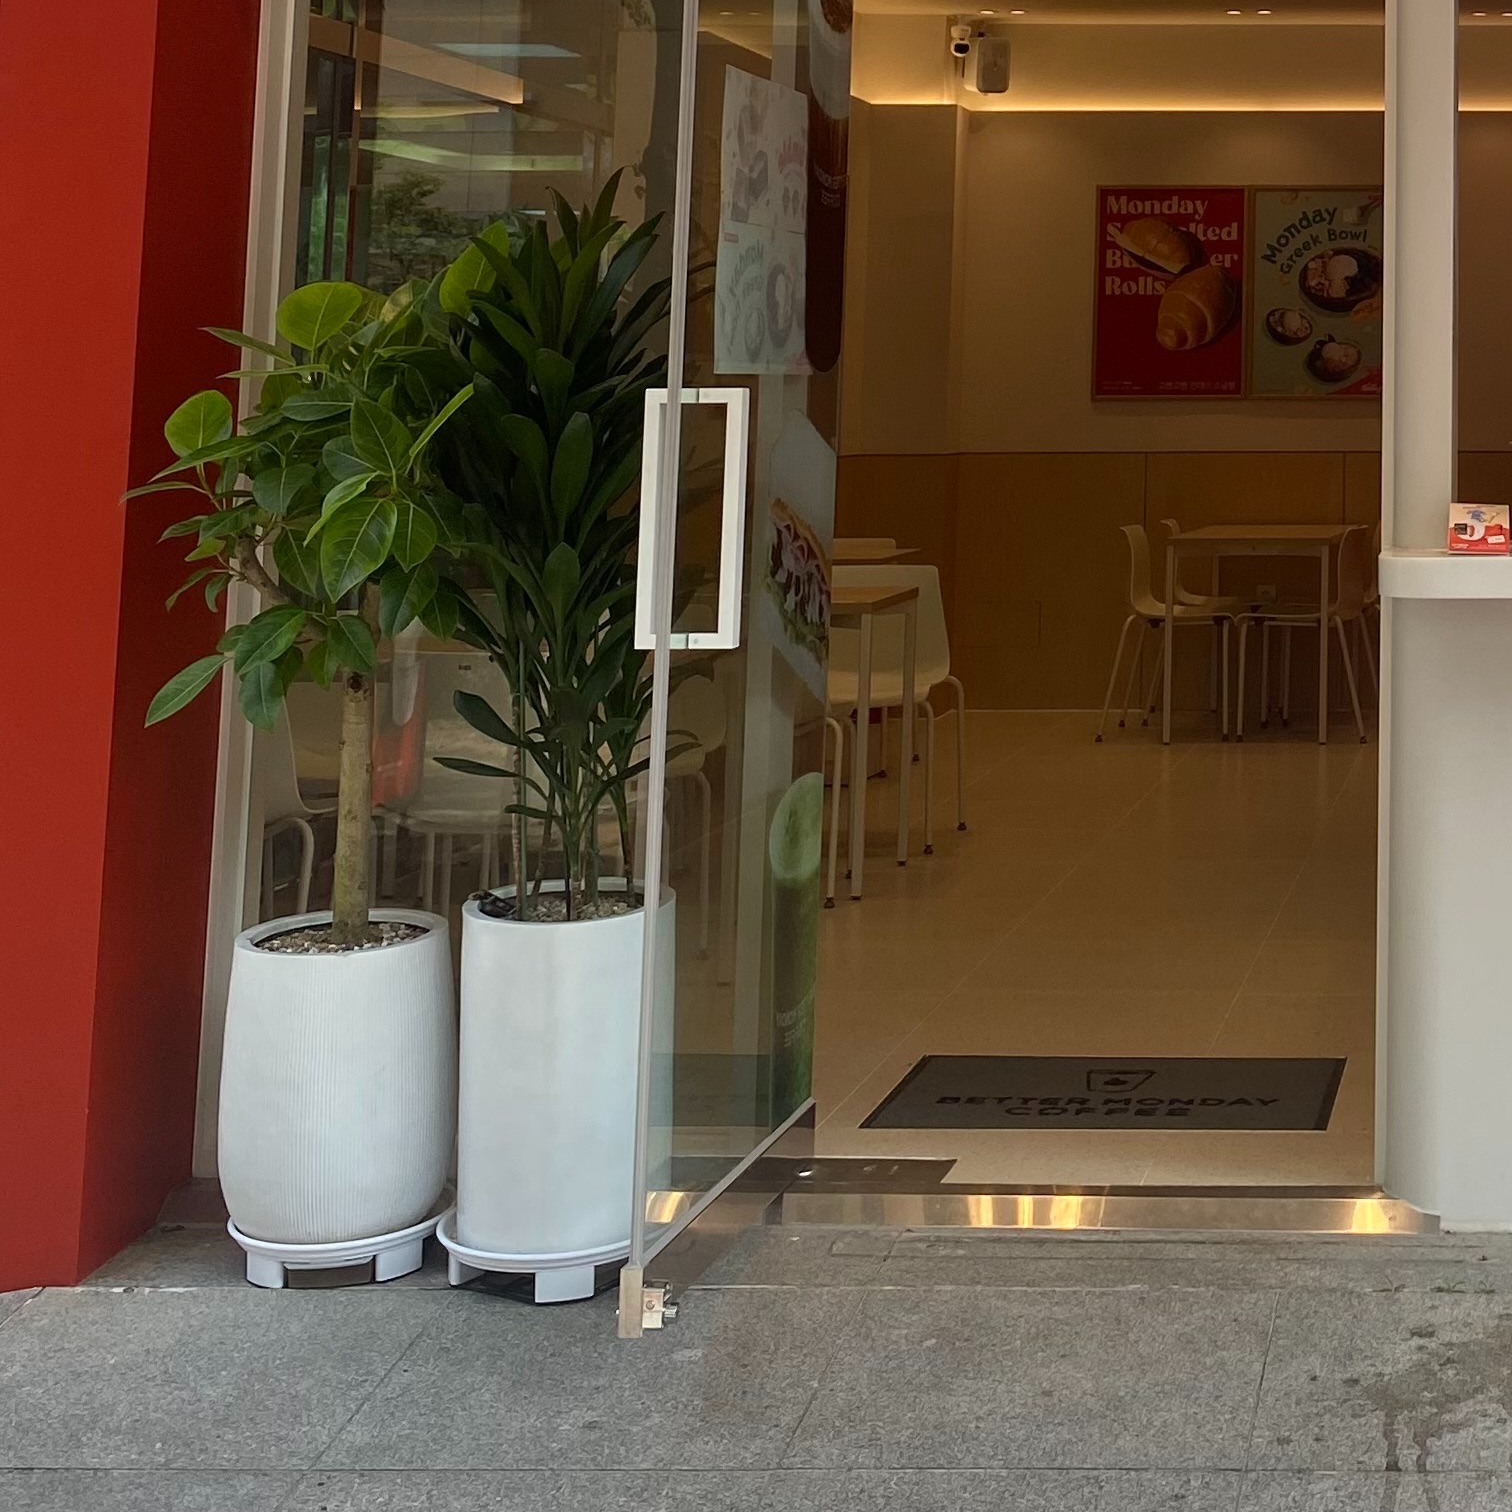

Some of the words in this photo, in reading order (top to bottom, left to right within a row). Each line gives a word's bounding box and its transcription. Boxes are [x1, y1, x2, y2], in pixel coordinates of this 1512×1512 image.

[1106, 194, 1209, 220] Monday
[1261, 206, 1338, 265] Monday
[1280, 233, 1323, 275] Greek
[1327, 227, 1368, 244] Bowl
[1104, 275, 1166, 297] Rolls
[936, 1096, 1089, 1106] BETTER
[1102, 1096, 1279, 1106] MONDAY
[1005, 1107, 1192, 1116] COFFEE
